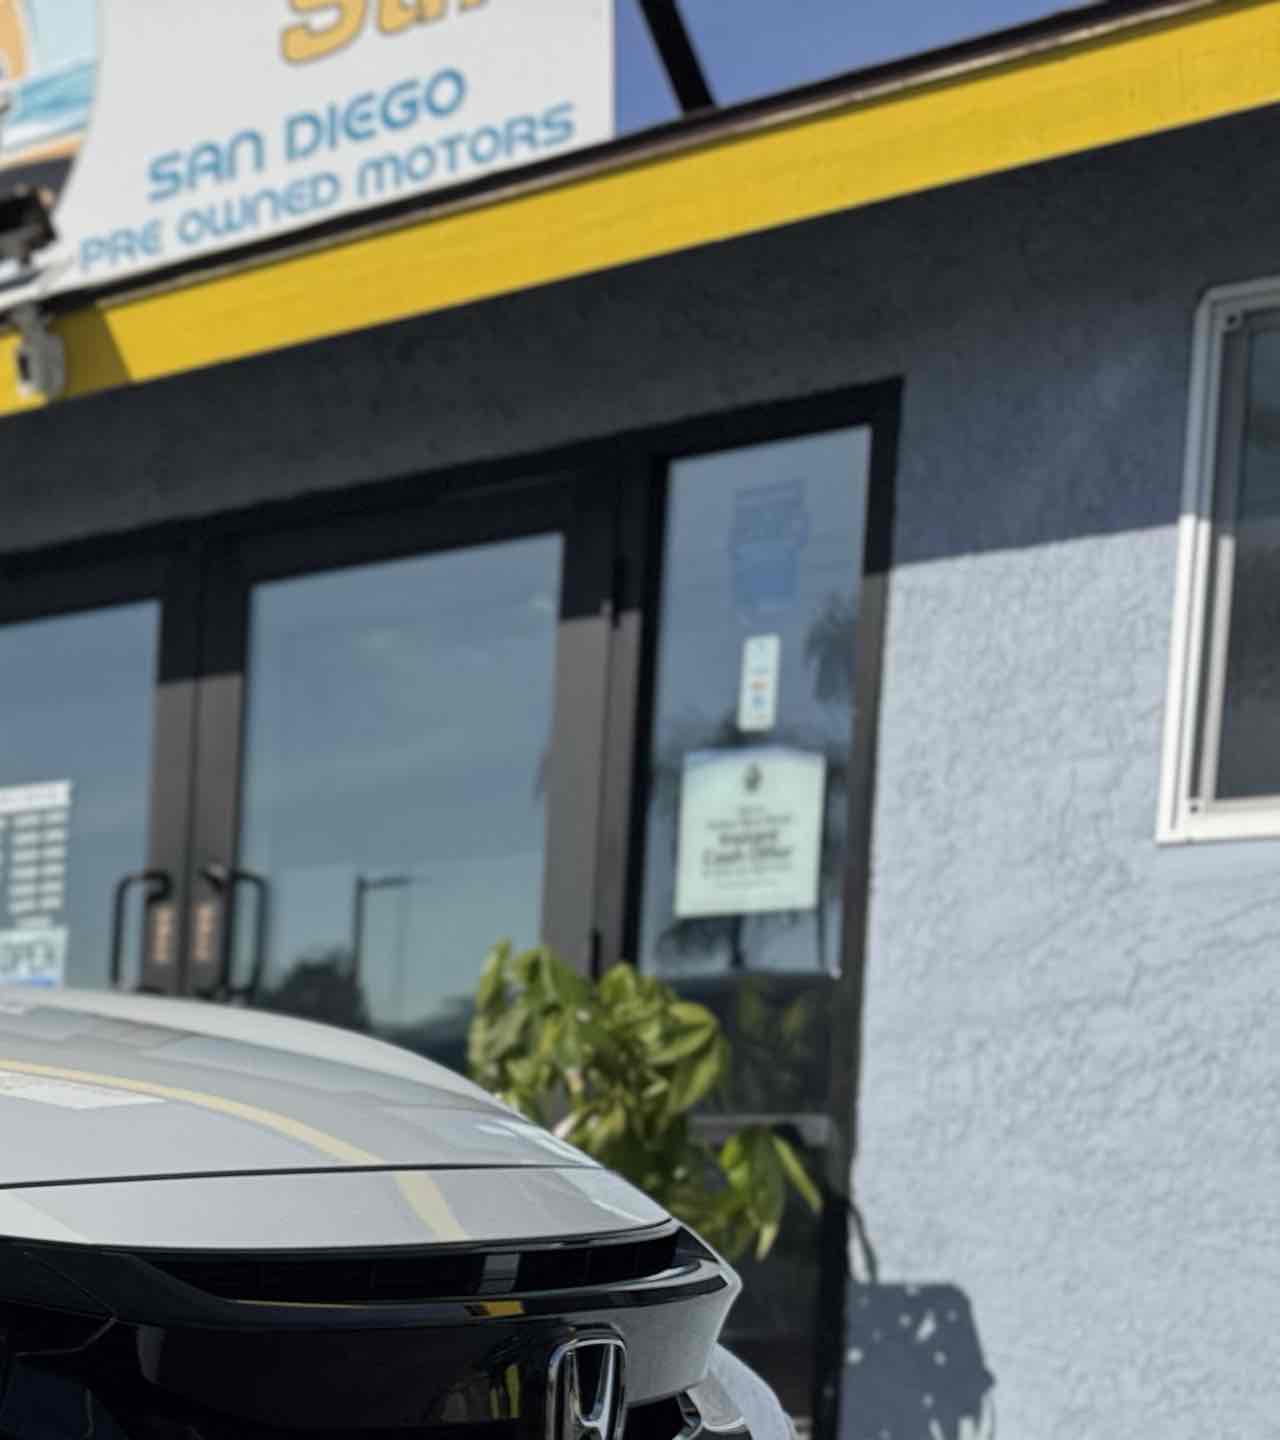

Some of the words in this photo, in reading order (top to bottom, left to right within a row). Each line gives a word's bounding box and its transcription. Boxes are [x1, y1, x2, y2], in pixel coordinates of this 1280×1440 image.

[78, 220, 164, 273] PRE
[176, 169, 342, 245] OWNED
[356, 101, 577, 197] MOTORS
[147, 128, 265, 203] SAN
[283, 67, 467, 162] DIEGO
